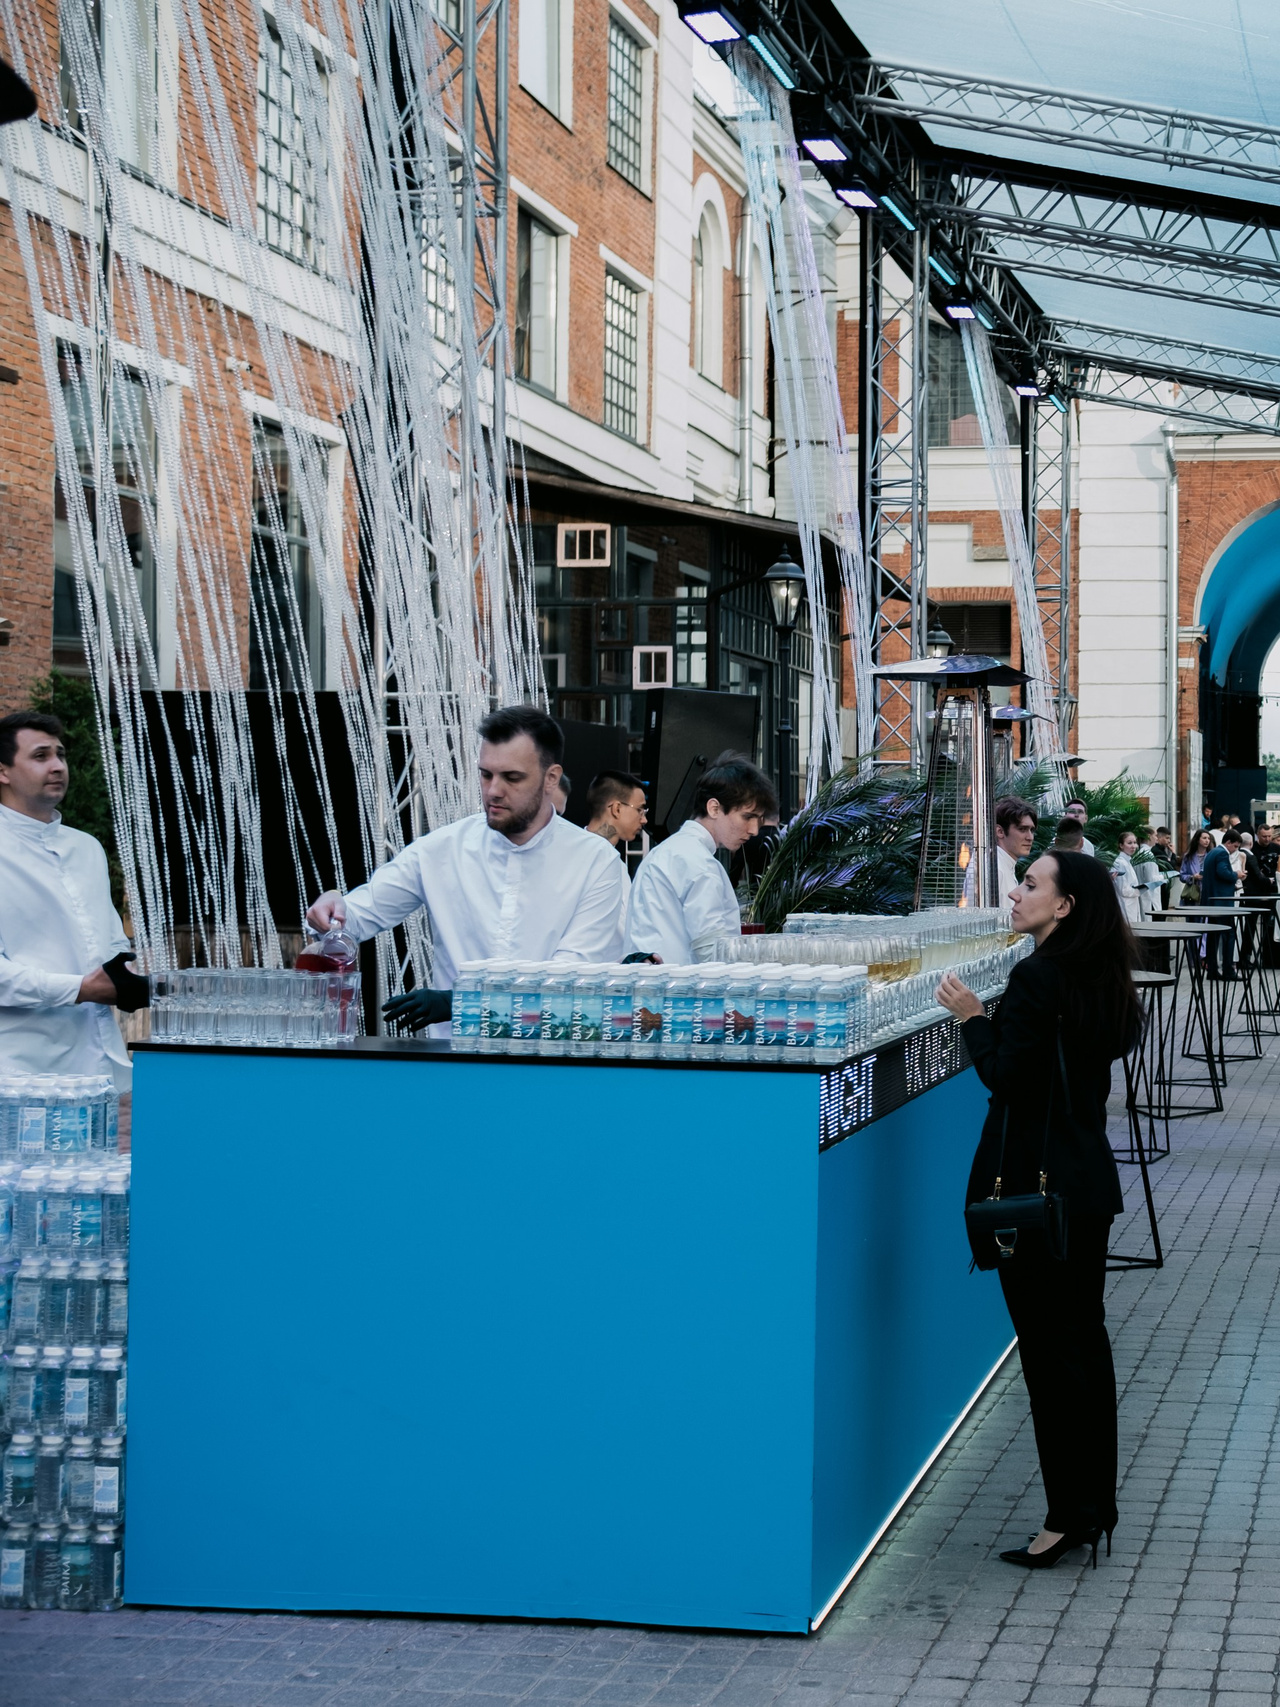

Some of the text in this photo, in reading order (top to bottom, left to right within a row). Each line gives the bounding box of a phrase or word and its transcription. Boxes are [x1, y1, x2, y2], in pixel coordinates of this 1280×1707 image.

[453, 994, 463, 1035] BAIKAL
[481, 995, 491, 1037] BAIKAL
[512, 995, 523, 1037] BAIKAL
[542, 997, 552, 1038] BAIKAL
[572, 998, 582, 1039] BAIKAL
[602, 999, 613, 1040] BAIKAL
[632, 1000, 643, 1041] BAIKAL
[662, 1001, 673, 1042] BAIKAL
[692, 1001, 703, 1042] BAIKAL
[725, 1002, 735, 1043] BAIKAL
[755, 1002, 765, 1044] BAIKAL
[786, 1004, 798, 1045] BAIKAL
[816, 1004, 827, 1046] BAIKAL
[52, 1110, 62, 1150] BAIKAL
[72, 1205, 82, 1246] BAIKAL
[4, 1468, 14, 1507] BAIKAL
[61, 1554, 72, 1596] BAIKAL
